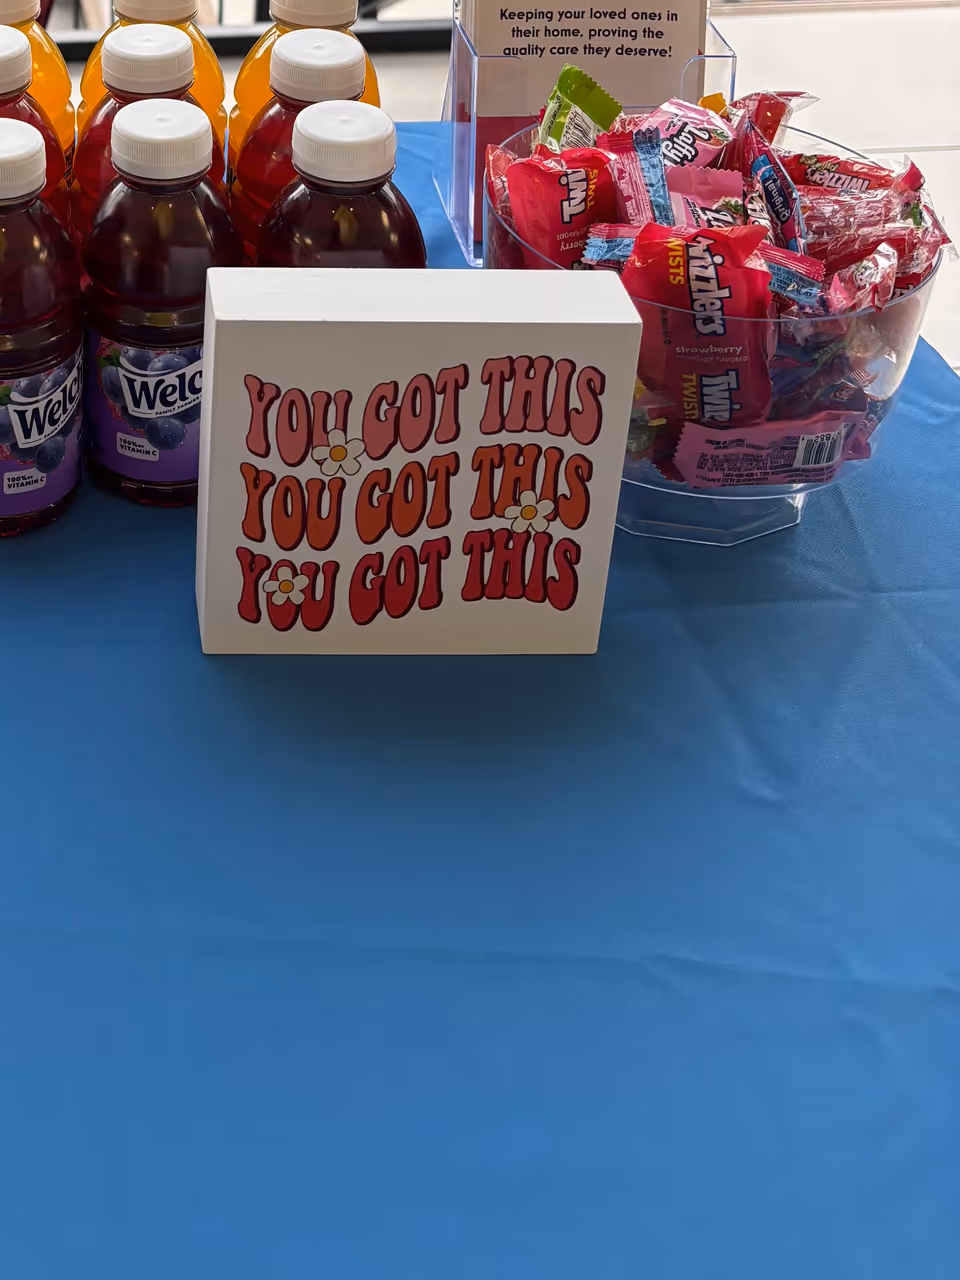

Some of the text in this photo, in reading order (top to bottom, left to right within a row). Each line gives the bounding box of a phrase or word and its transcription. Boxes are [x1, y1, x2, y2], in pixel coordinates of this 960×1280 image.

[500, 7, 678, 23] Keeping your loved ones in
[511, 26, 665, 41] their home, proving the
[549, 46, 579, 56] care
[583, 44, 611, 58] they
[615, 44, 672, 58] deserve!
[764, 179, 789, 221] Original
[675, 345, 743, 355] strawberry
[155, 406, 176, 416] FAMILY
[244, 355, 606, 467] YOU GOT THIS
[120, 437, 138, 448] 100%
[120, 443, 151, 456] VITAMIN
[7, 475, 27, 483] 100%
[7, 478, 39, 489] VITAMIN
[240, 462, 346, 551] YOU
[355, 451, 460, 545] GOT
[470, 443, 593, 530] THIS
[236, 528, 581, 632] YOU GOT THIS
